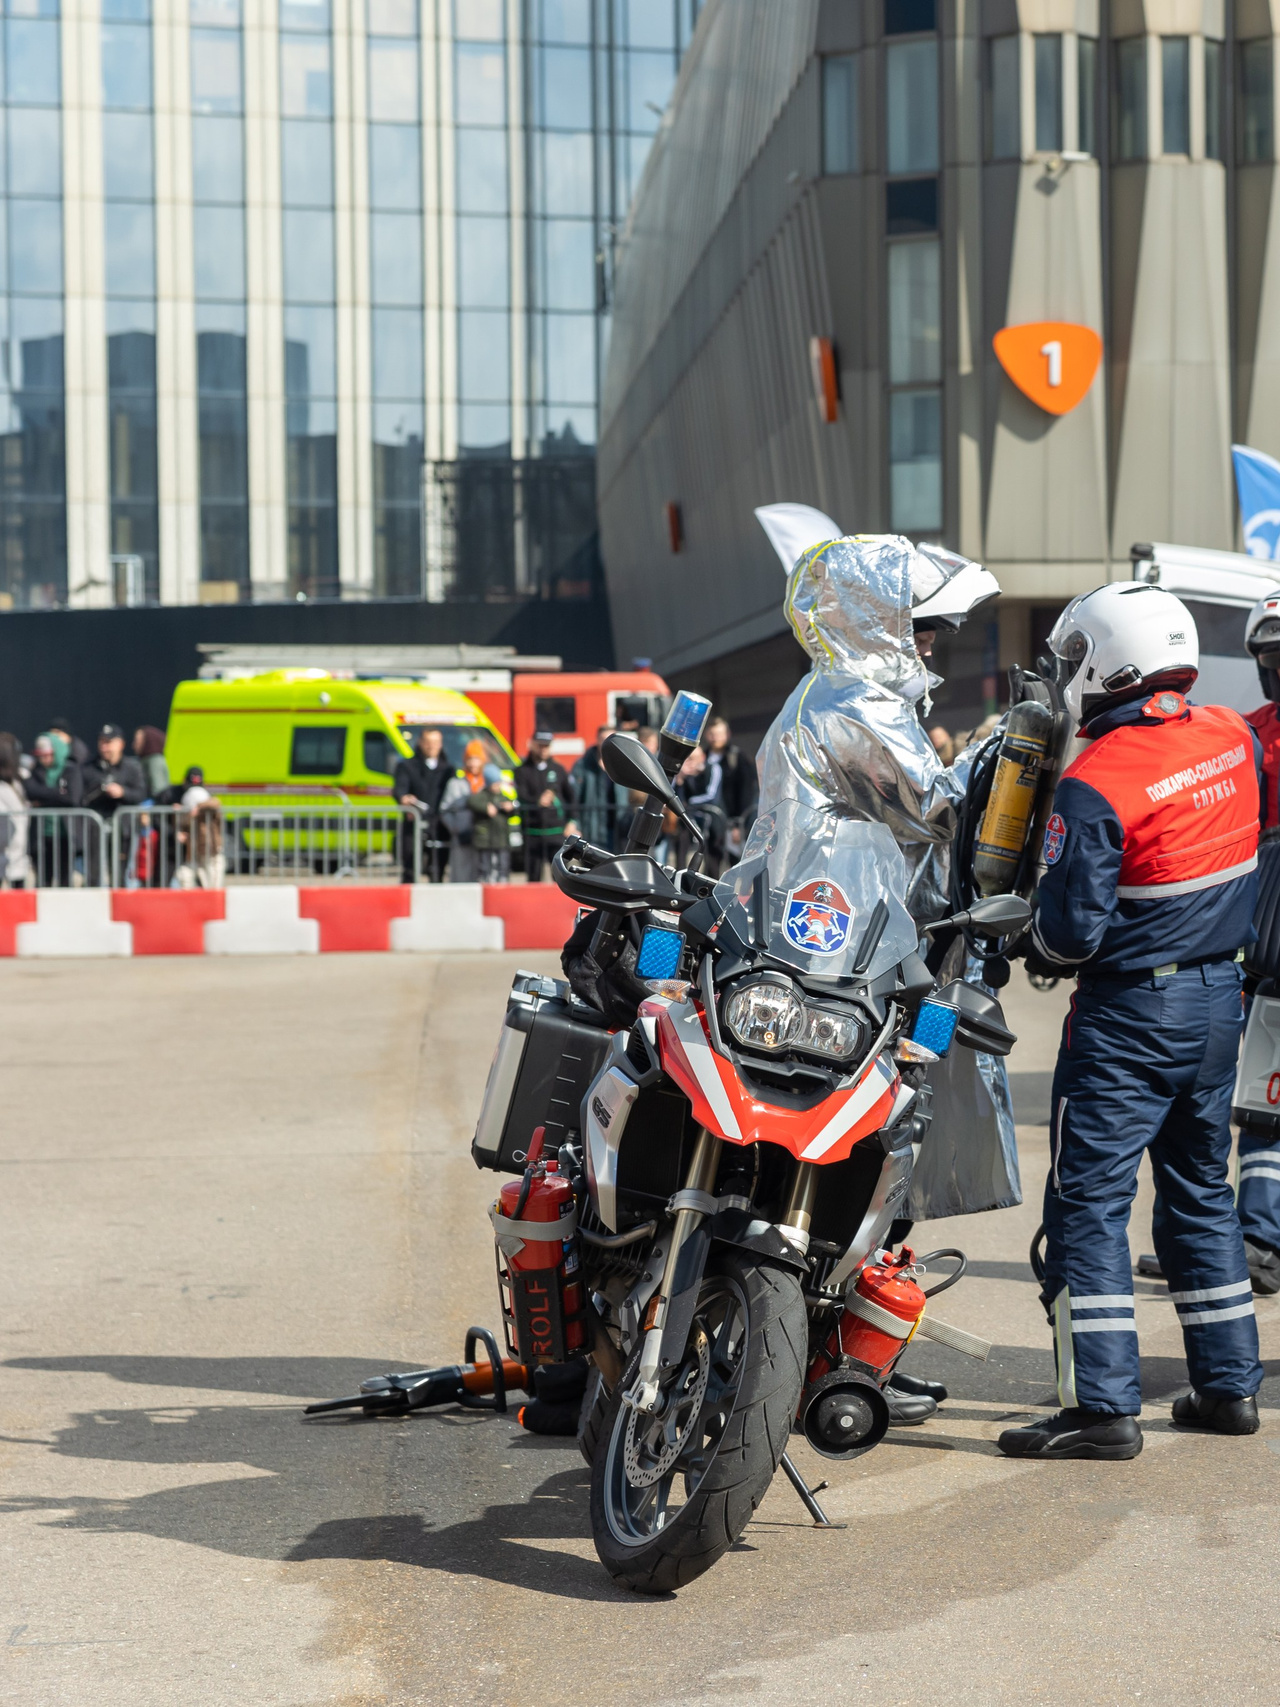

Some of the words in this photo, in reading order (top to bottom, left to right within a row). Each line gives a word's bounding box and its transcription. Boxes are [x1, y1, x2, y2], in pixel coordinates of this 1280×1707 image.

[1041, 340, 1062, 387] 1
[1192, 777, 1237, 810] СЛУЖБА
[525, 1279, 554, 1356] ROLF
